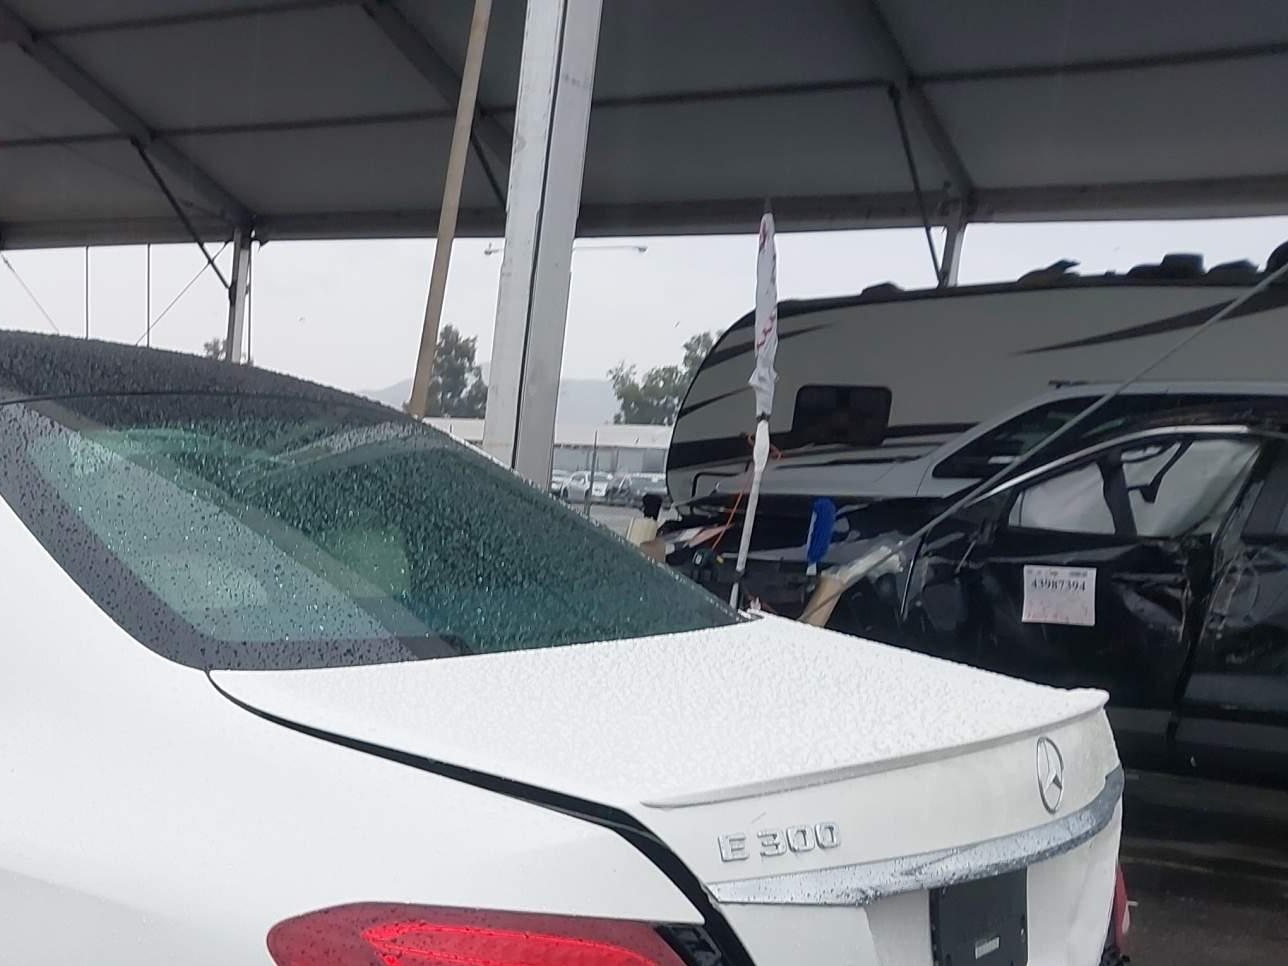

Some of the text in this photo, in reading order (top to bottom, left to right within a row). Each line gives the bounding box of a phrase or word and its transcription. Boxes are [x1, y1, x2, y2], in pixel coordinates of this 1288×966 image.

[1031, 577, 1086, 592] 43987394
[718, 822, 840, 862] E 300
